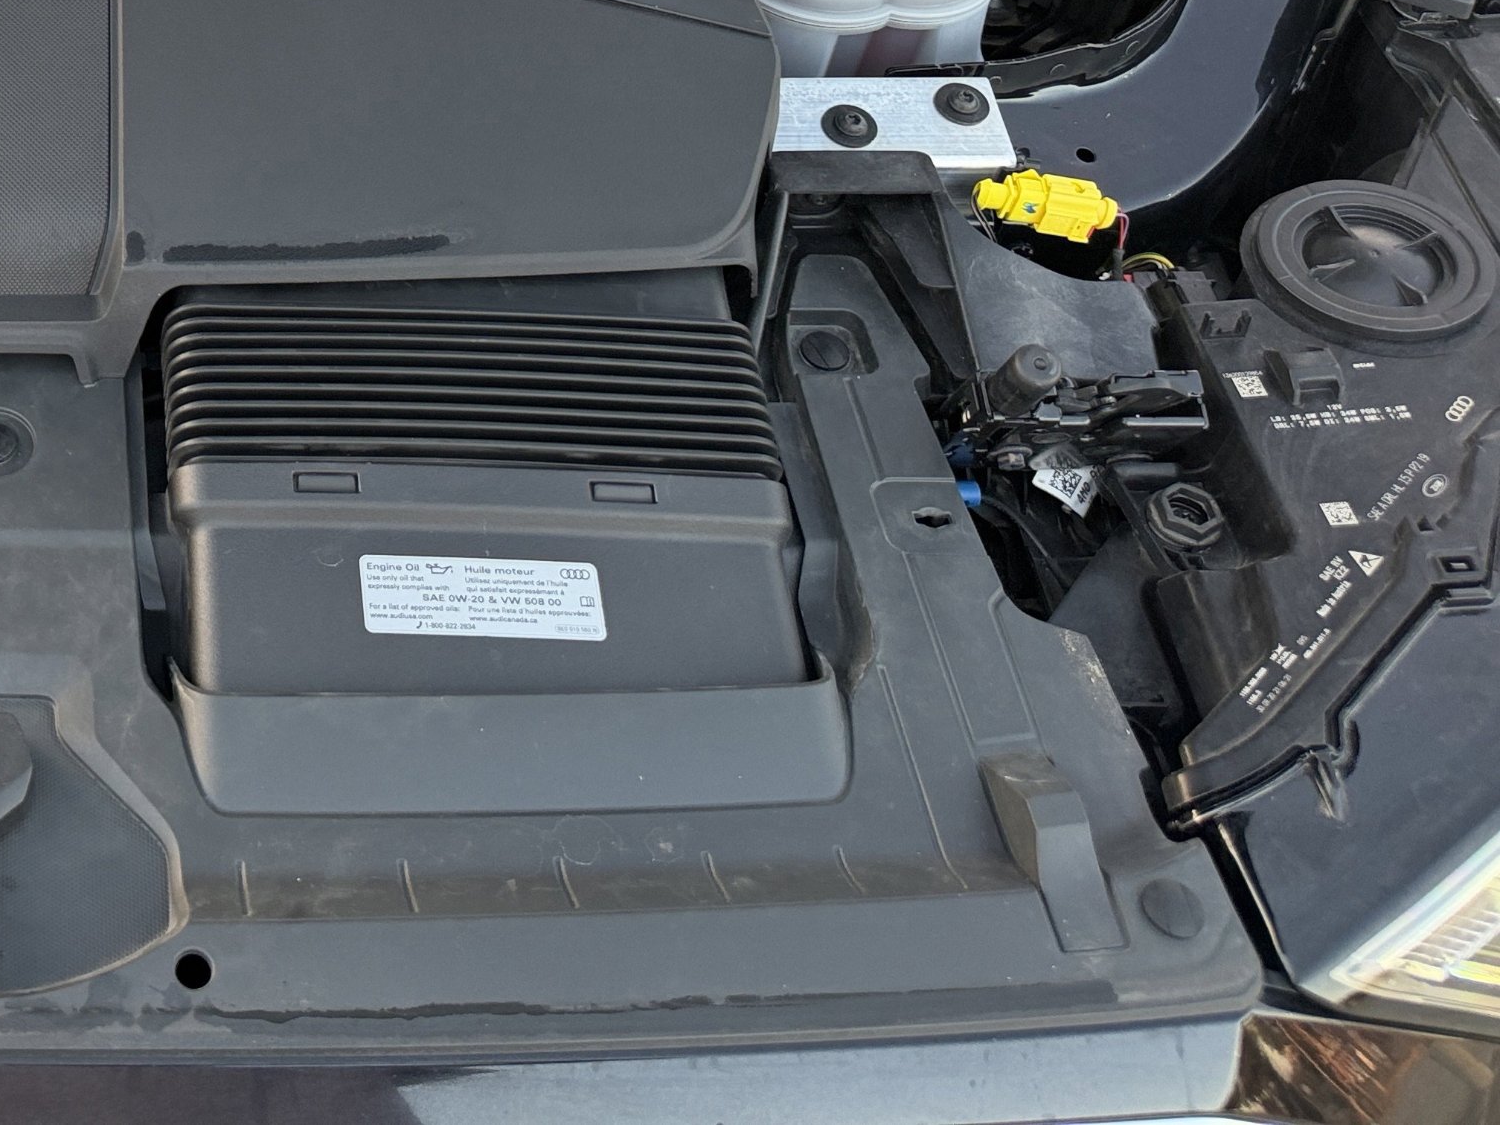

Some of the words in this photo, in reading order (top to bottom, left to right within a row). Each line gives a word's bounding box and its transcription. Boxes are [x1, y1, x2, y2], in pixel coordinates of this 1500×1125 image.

[1367, 506, 1384, 521] SAE
[366, 562, 402, 572] Engine
[405, 563, 420, 571] Oil
[464, 566, 491, 574] Huile
[495, 567, 535, 575] moteur
[493, 578, 534, 586] uniquement
[422, 593, 445, 602] SAE
[448, 594, 485, 603] 0W-20
[488, 595, 497, 604] &
[501, 596, 520, 605] VW
[525, 597, 545, 606] 508
[548, 598, 562, 606] 00
[468, 605, 485, 613] Pour
[502, 606, 517, 614] liste
[470, 615, 538, 624] www.audicanada.ca
